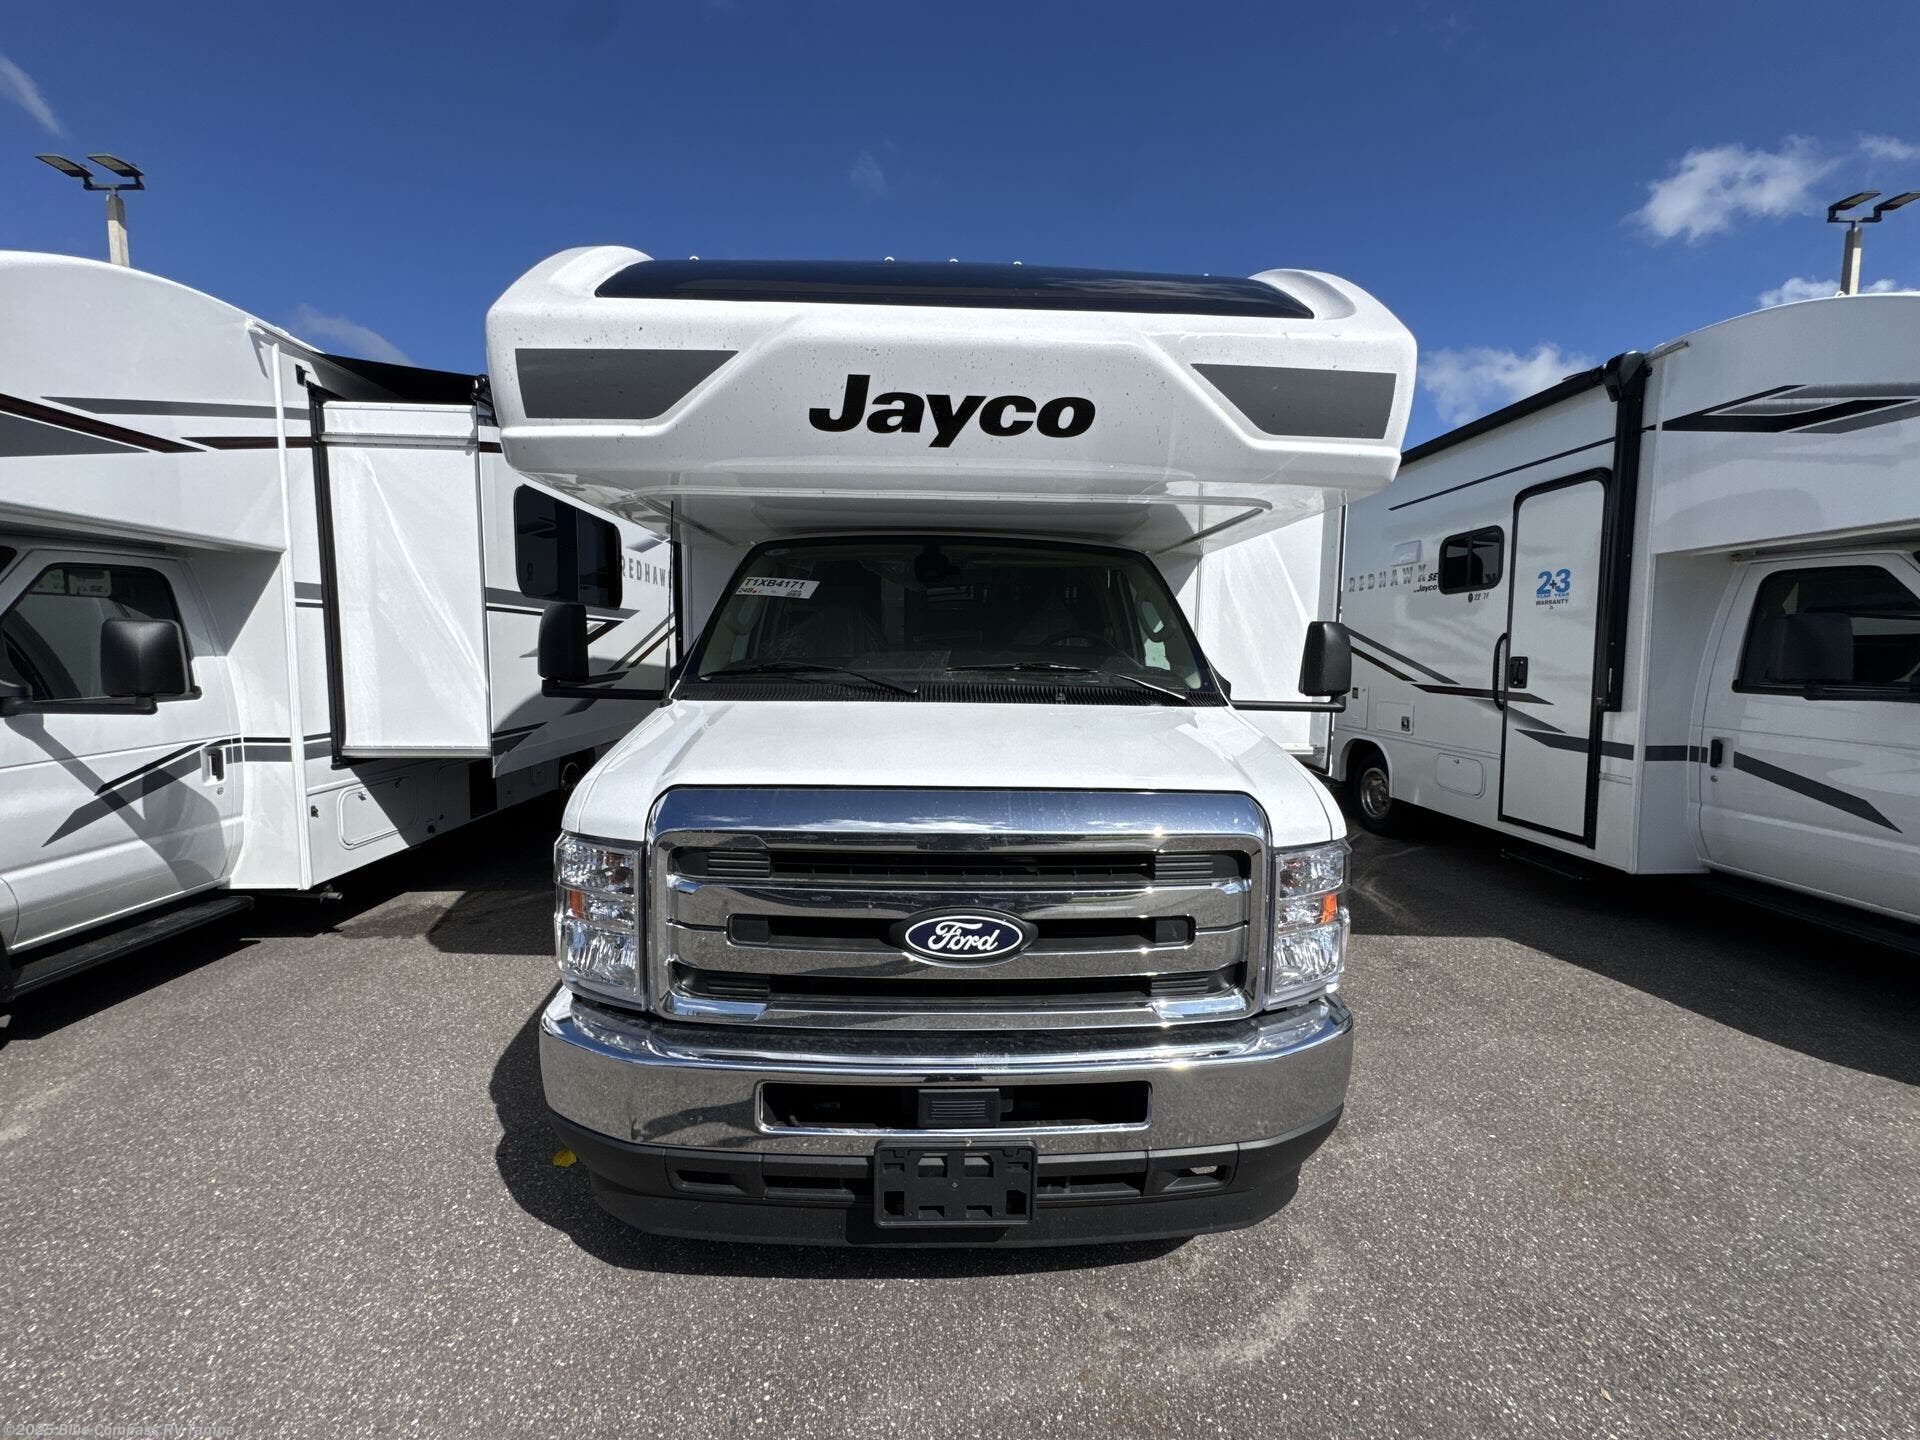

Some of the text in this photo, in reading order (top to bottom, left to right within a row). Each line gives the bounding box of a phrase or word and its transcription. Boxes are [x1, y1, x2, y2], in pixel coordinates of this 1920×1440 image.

[809, 374, 1096, 448] Jayco
[744, 578, 806, 589] T1XB4171
[1348, 564, 1426, 592] REDHAWK
[927, 921, 1001, 951] Ford
